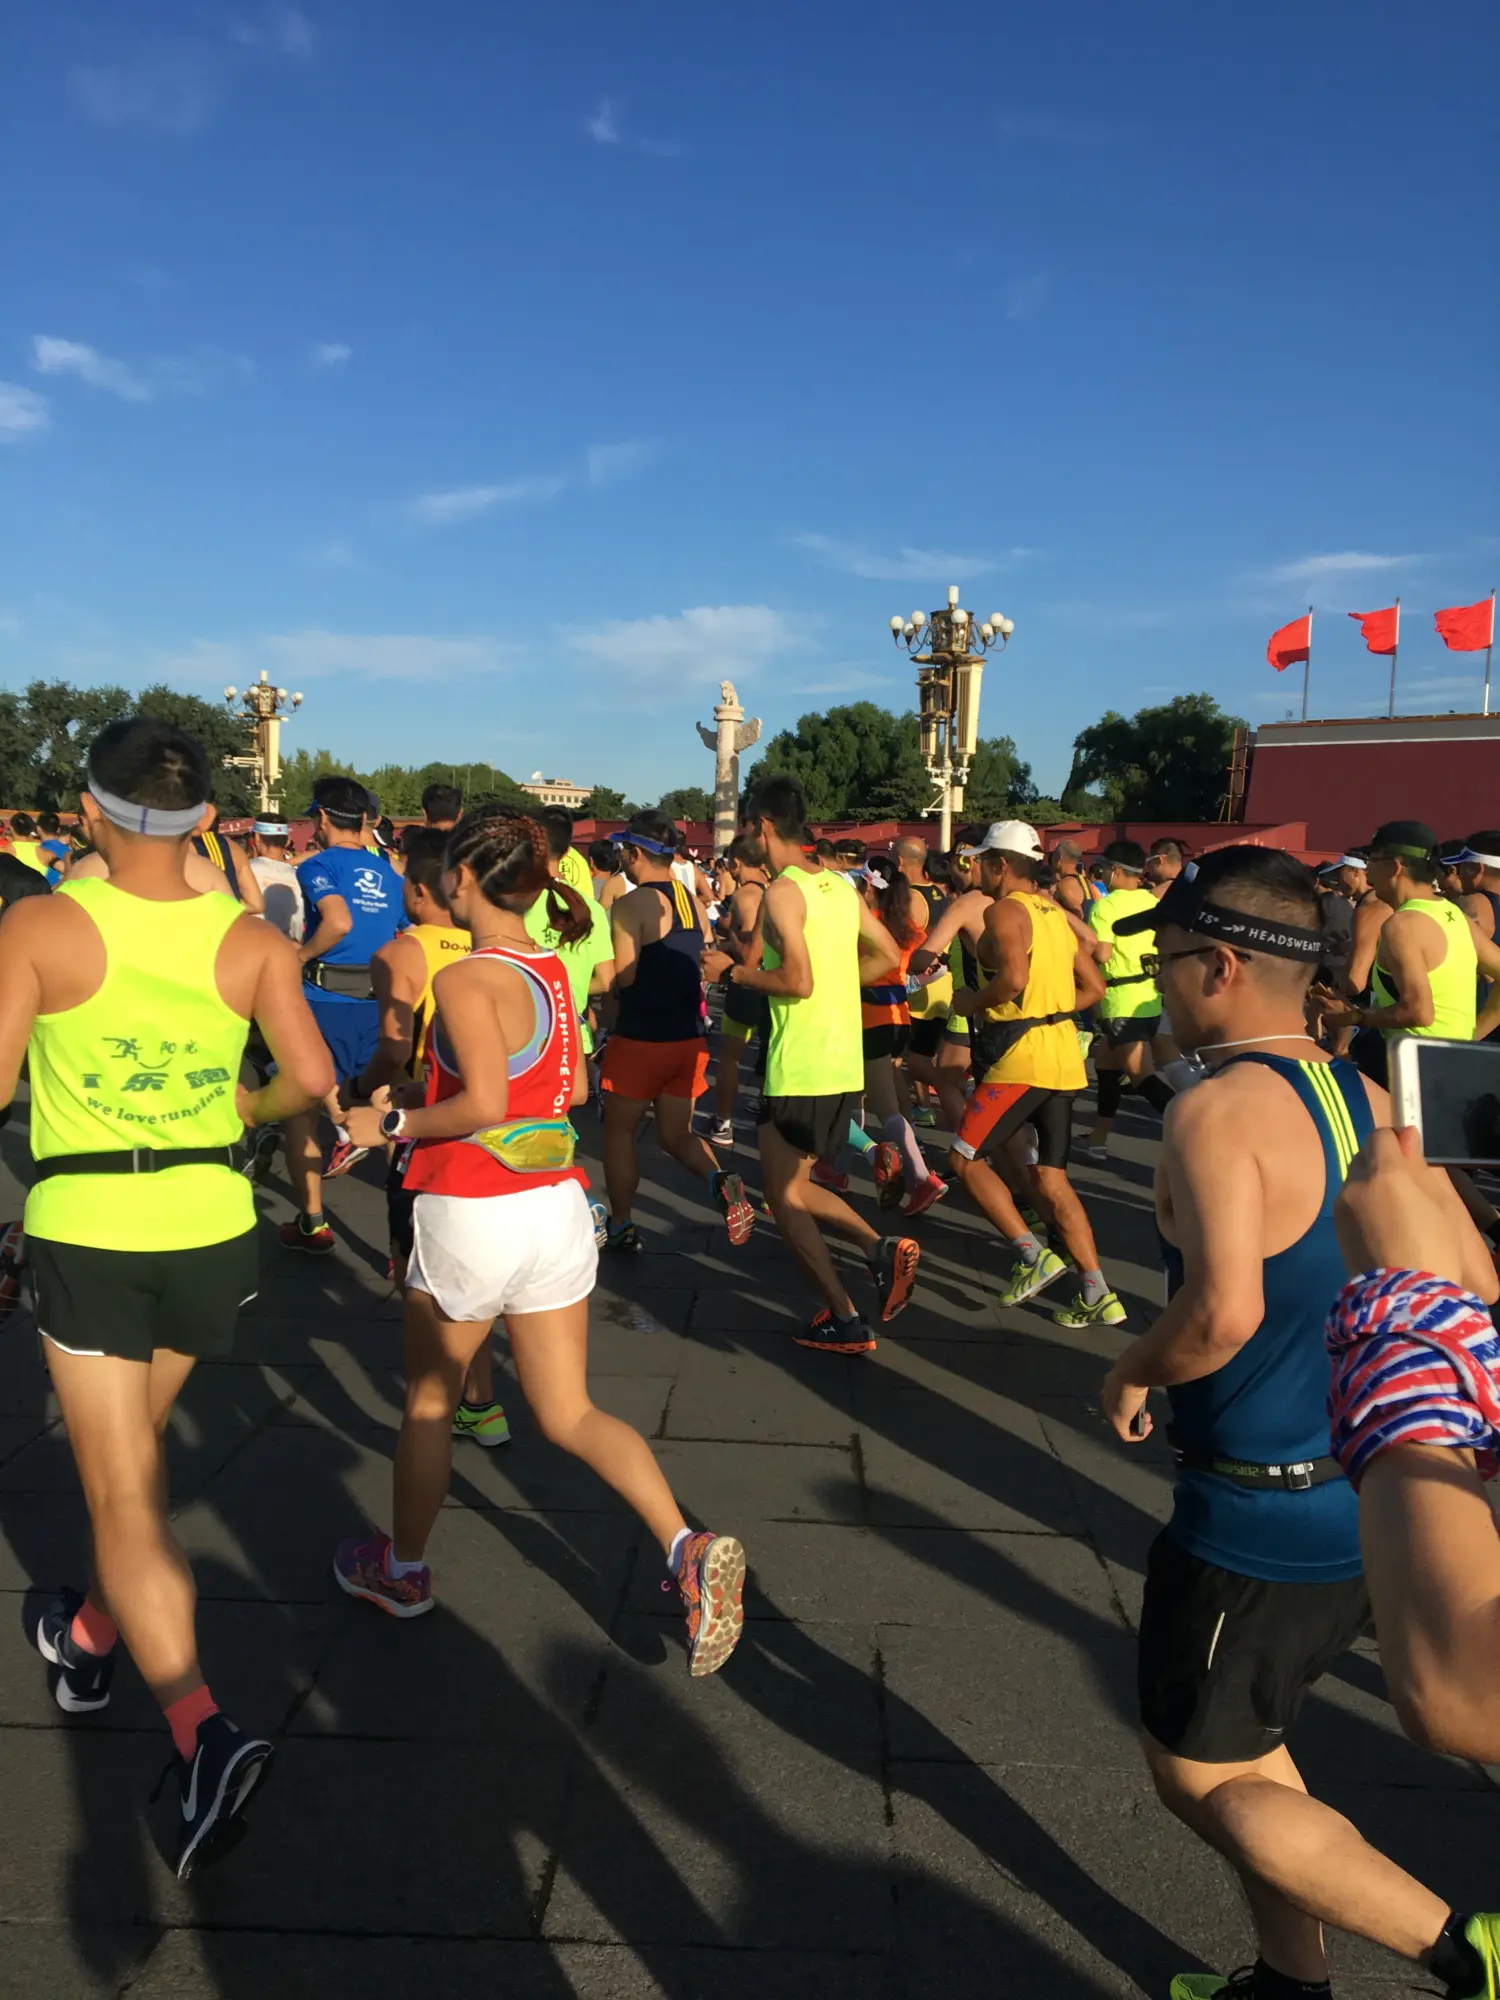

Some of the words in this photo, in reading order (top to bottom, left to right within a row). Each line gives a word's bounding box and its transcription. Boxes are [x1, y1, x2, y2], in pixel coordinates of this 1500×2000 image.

[87, 1096, 112, 1115] we
[116, 1108, 156, 1124] love
[160, 1085, 226, 1124] running
